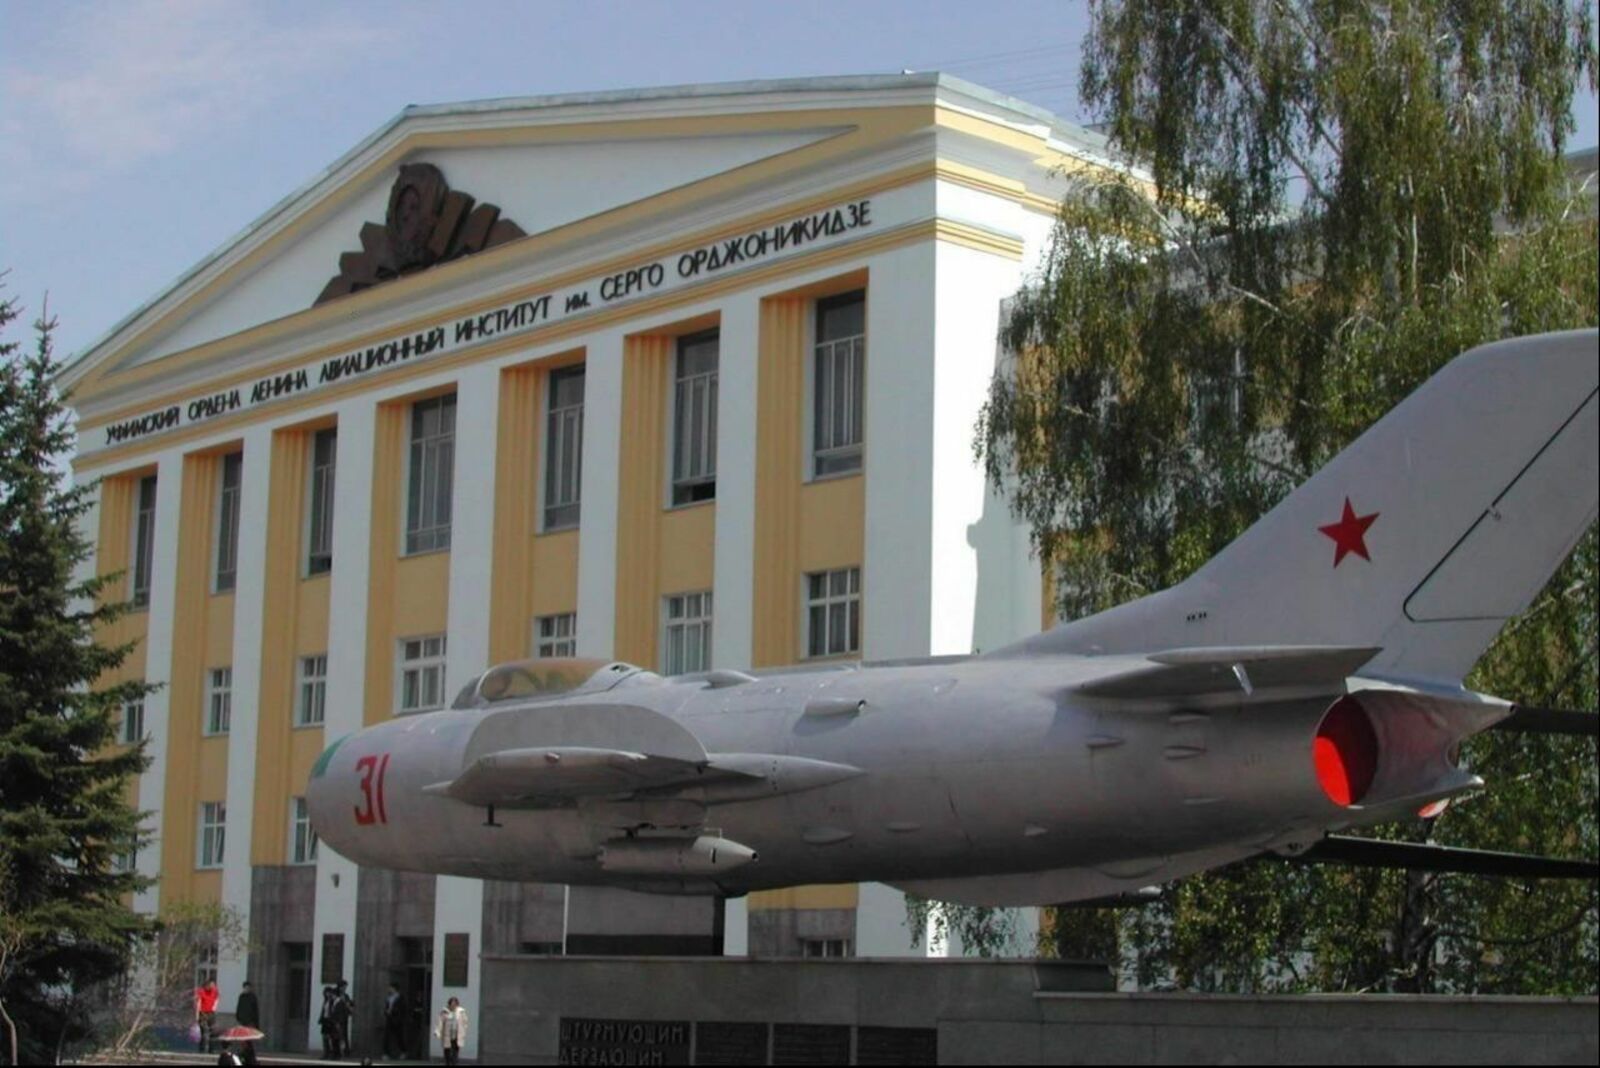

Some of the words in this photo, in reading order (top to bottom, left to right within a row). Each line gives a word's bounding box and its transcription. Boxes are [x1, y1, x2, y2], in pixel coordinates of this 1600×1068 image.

[188, 389, 241, 421] ОРДЕНА
[251, 369, 308, 403] ЛЕНИНА
[319, 327, 445, 383] АВИАЦИОННЫЙ
[455, 296, 552, 343] ИНСТИТУТ
[600, 264, 664, 300] СЕРГО
[677, 200, 871, 278] ОРДЖОНИКИДЗЕ
[354, 753, 390, 826] 31
